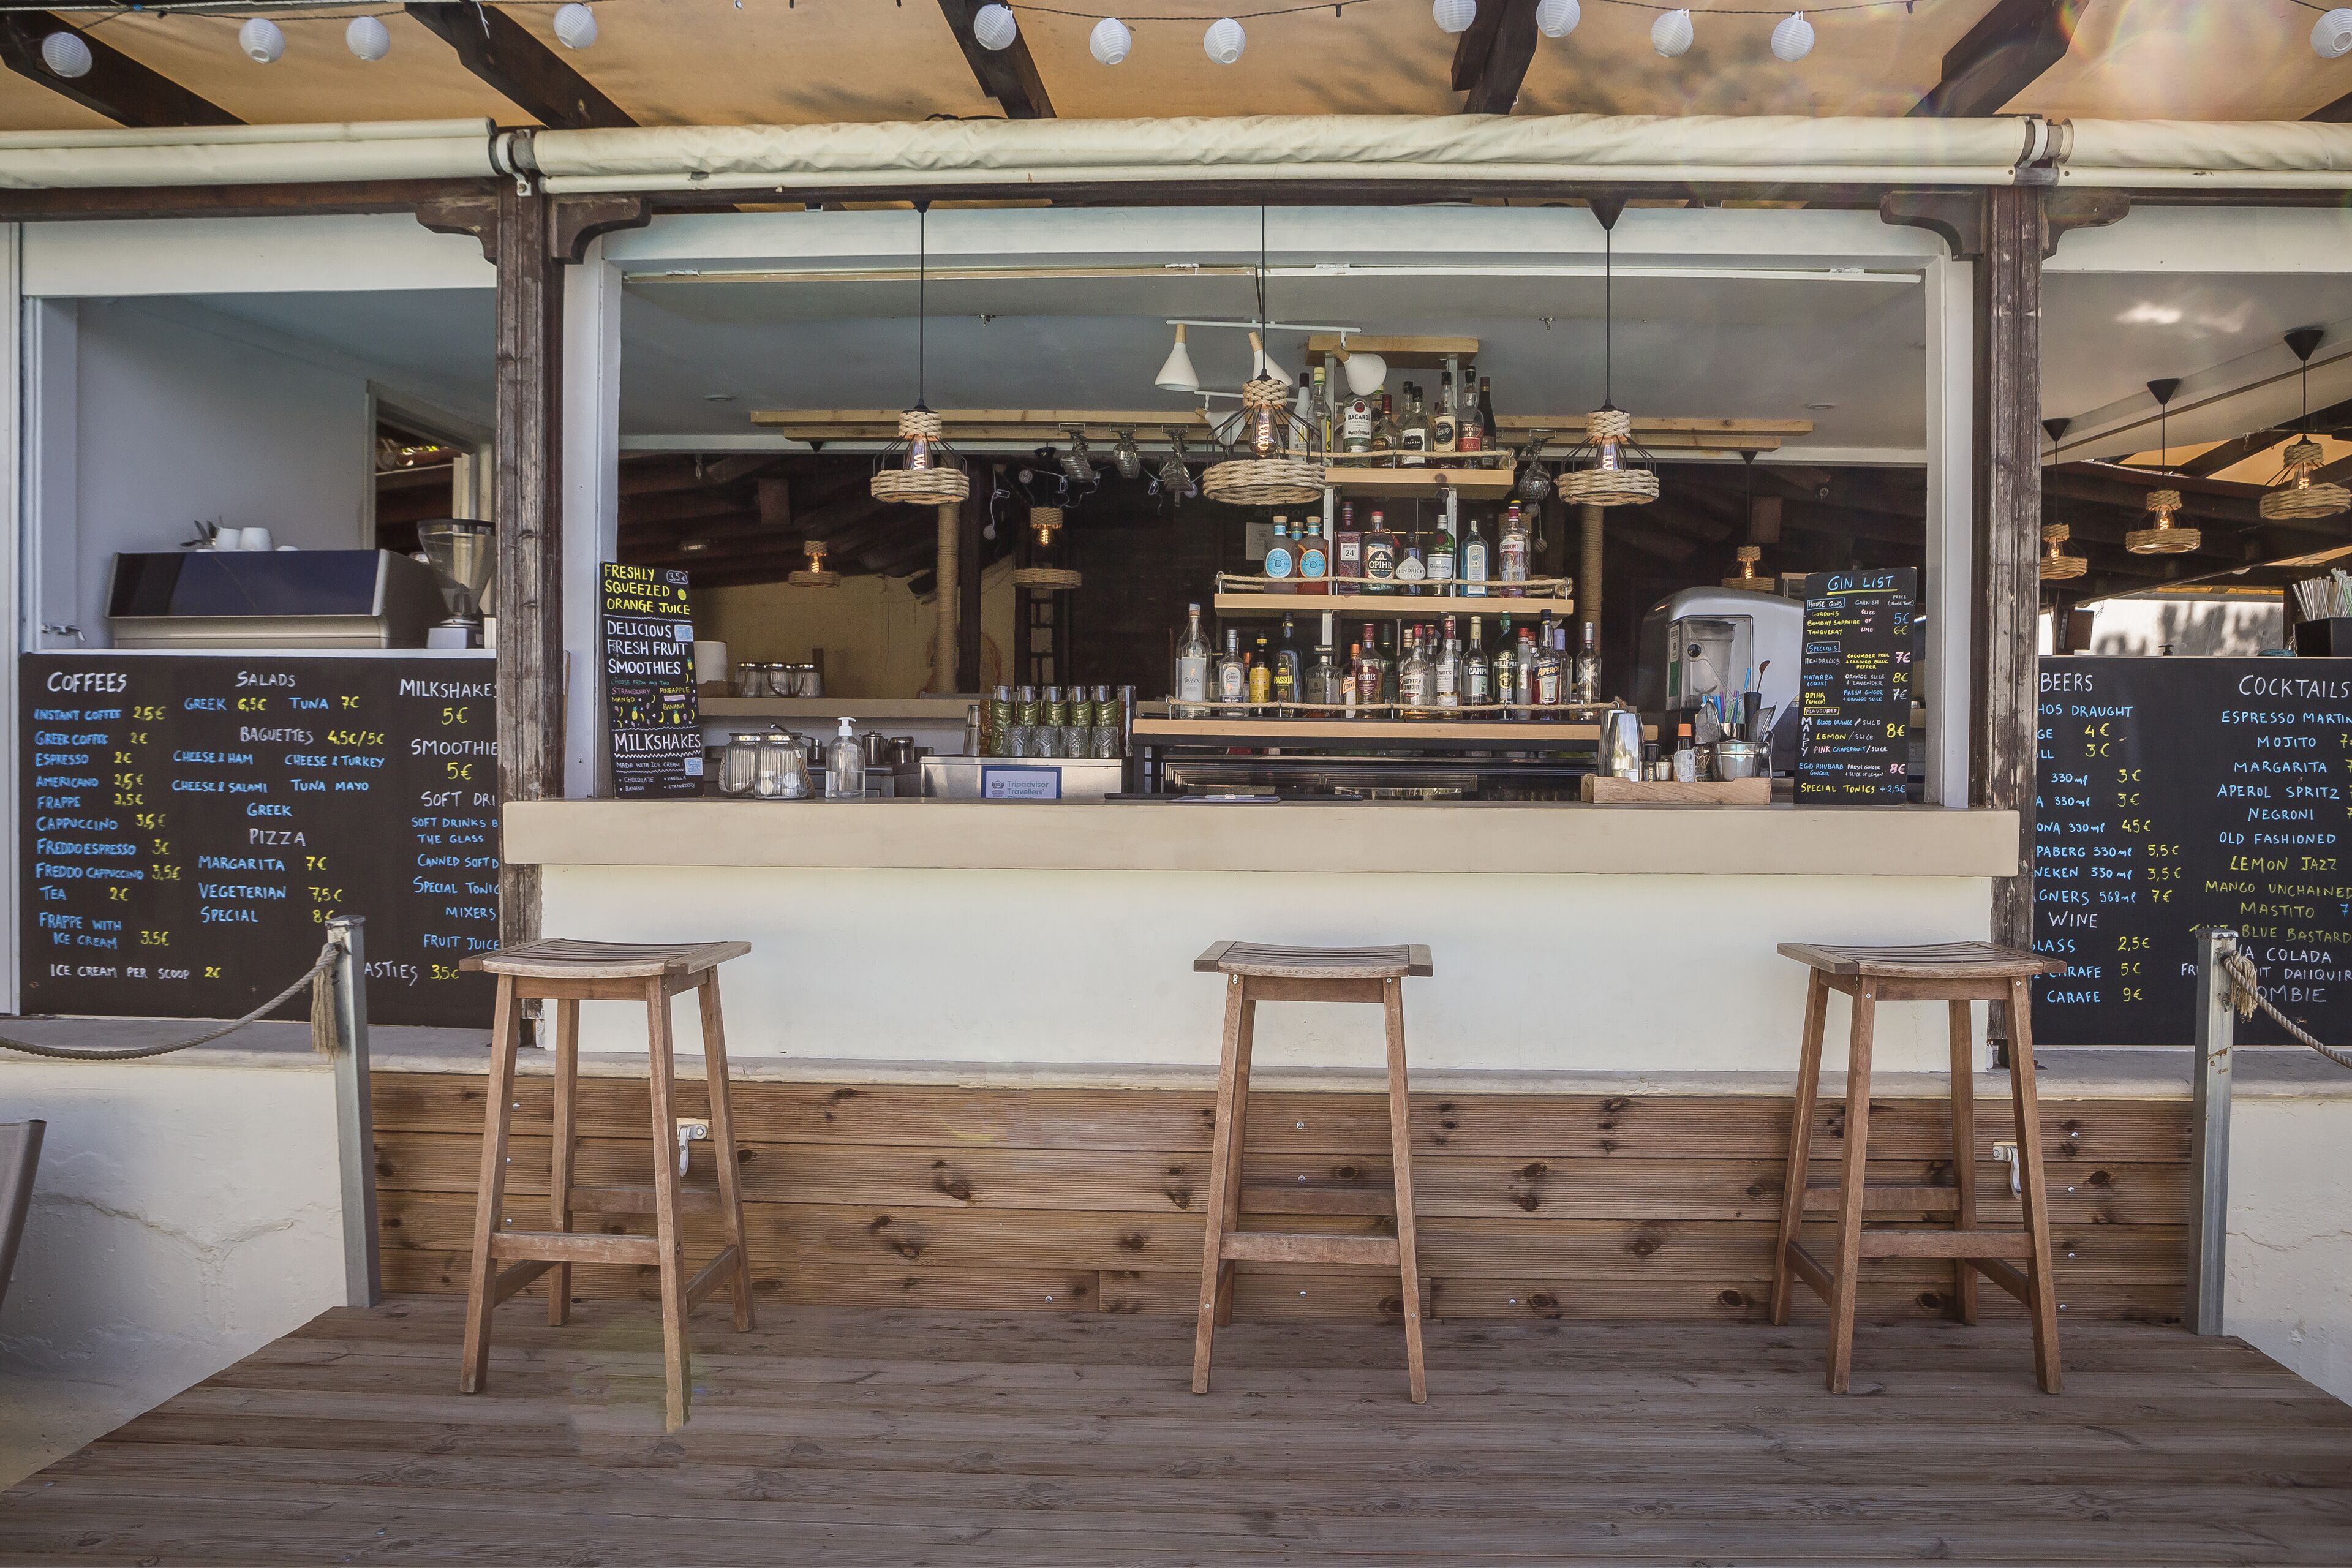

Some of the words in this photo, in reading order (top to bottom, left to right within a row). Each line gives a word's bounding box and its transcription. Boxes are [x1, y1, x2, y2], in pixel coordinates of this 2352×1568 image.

[605, 564, 654, 582] FRESHLY
[605, 580, 670, 597] SQUEEZED
[1828, 576, 1853, 590] GIN
[1863, 575, 1894, 589] LIST
[607, 598, 654, 612] ORANGE
[658, 602, 690, 615] JUICE
[1894, 612, 1910, 625] 5€
[607, 620, 671, 638] DELICIOUS
[1894, 625, 1907, 635] 6€
[607, 639, 649, 655] FRESH
[653, 642, 688, 655] FRUIT
[1896, 652, 1911, 663] 7€
[608, 658, 681, 674] SMOOTHIES
[47, 672, 127, 692] COFFEES
[235, 671, 296, 687] SALADS
[1893, 672, 1908, 683] 8€
[2040, 673, 2093, 692] BEERS
[2239, 675, 2350, 698] COCKTAILS
[1893, 688, 1907, 701] 7€
[184, 698, 227, 711] GREEK
[288, 697, 329, 710] TUNA
[341, 696, 360, 710] 7€
[34, 710, 80, 720] INSTANT
[84, 709, 122, 720] COFFEE
[441, 707, 469, 725] 5€
[2071, 706, 2133, 718] DRAUGHT
[2222, 710, 2295, 725] ESPRESSO
[240, 726, 314, 745] BAGUETTES
[1887, 723, 1905, 737] 8€
[34, 731, 69, 745] GREEK
[72, 734, 109, 745] COFFEE
[130, 731, 148, 744] 2€
[614, 733, 701, 752] MILKSHAKES
[2257, 736, 2316, 748] MOJITO
[35, 753, 89, 767] ESPRESSO
[114, 751, 132, 764] 2€
[173, 750, 217, 763] CHEESE
[227, 753, 254, 766] HAM
[284, 755, 327, 767] CHEESE
[341, 755, 385, 768] TURKEY
[447, 762, 472, 780] 5€
[1890, 763, 1905, 774] 8€
[2234, 761, 2327, 773] MARGARITA
[36, 775, 99, 788] AMERICANO
[172, 780, 217, 792] CHEESE
[227, 782, 268, 794] SALAMI
[290, 779, 326, 792] TUNA
[335, 782, 369, 791] MAYO
[1801, 783, 1836, 793] SPECIAL
[1843, 785, 1875, 794] TONICS
[421, 791, 462, 807] SOFT
[2217, 784, 2271, 798] APEROL
[2286, 786, 2340, 799] SPRITZ
[37, 796, 81, 810] FRAPPE
[247, 802, 293, 817] GREEK
[411, 817, 437, 827] SOFT
[442, 818, 486, 828] DRINKS
[2248, 809, 2313, 822] NEGRONI
[36, 816, 118, 831] CAPPUCCINO
[249, 828, 306, 847] PIZZA
[417, 834, 442, 845] THE
[449, 835, 484, 843] GLASS
[2219, 831, 2244, 845] OLD
[2255, 833, 2336, 845] FASHIONED
[151, 839, 170, 855] 3€
[2037, 846, 2086, 858] PABERG
[198, 856, 285, 872] MARGARITA
[306, 856, 327, 871] 7€
[418, 853, 460, 867] CANNED
[465, 858, 489, 867] SOFT
[2230, 856, 2288, 873] LEMON
[2300, 857, 2337, 871] JAZZ
[36, 862, 83, 878] FREDDO
[86, 867, 145, 881] CAPPUCCINO
[198, 882, 287, 900] VEGETERIAN
[413, 876, 458, 893] SPECIAL
[2205, 881, 2255, 893] MANGO
[39, 885, 67, 901] TEA
[110, 886, 129, 902] 2€
[2152, 889, 2173, 903] 7€
[200, 907, 259, 924] SPECIAL
[446, 907, 496, 921] MIXERS
[2240, 902, 2315, 919] MASTITO
[39, 912, 83, 929] FRAPPE
[92, 919, 122, 931] WITH
[2048, 911, 2098, 928] WINE
[53, 932, 70, 945] ICE
[77, 934, 118, 949] CREAM
[424, 934, 461, 948] FRUIT
[2242, 924, 2277, 938] BLUE
[2286, 928, 2351, 944] BASTARD
[2267, 948, 2332, 963] COLADA
[50, 964, 72, 977] ICE
[77, 965, 118, 978] CREAM
[126, 967, 148, 979] PER
[158, 968, 190, 979] SCOOP
[204, 967, 222, 978] 2€
[2120, 962, 2141, 976] 5€
[2047, 990, 2101, 1003] CARAFE
[2123, 987, 2143, 1002] 9€
